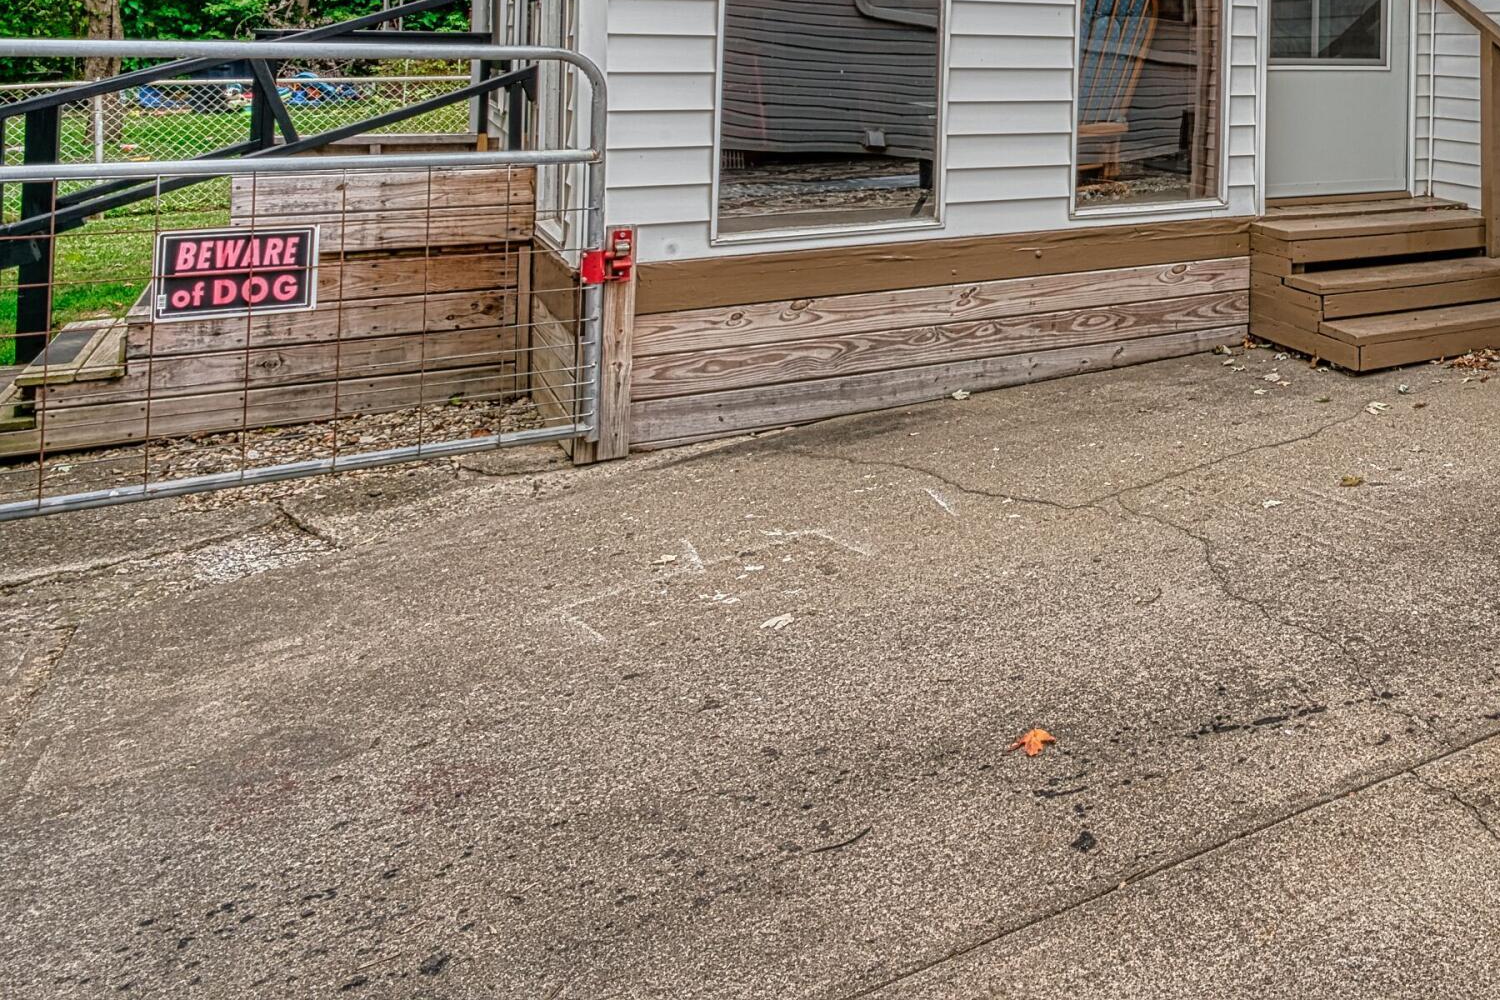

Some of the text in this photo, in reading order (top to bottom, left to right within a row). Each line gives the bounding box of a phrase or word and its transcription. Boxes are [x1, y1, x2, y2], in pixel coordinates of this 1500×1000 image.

[175, 237, 300, 271] BEWARE
[172, 281, 205, 309] of
[213, 274, 298, 305] DOG
